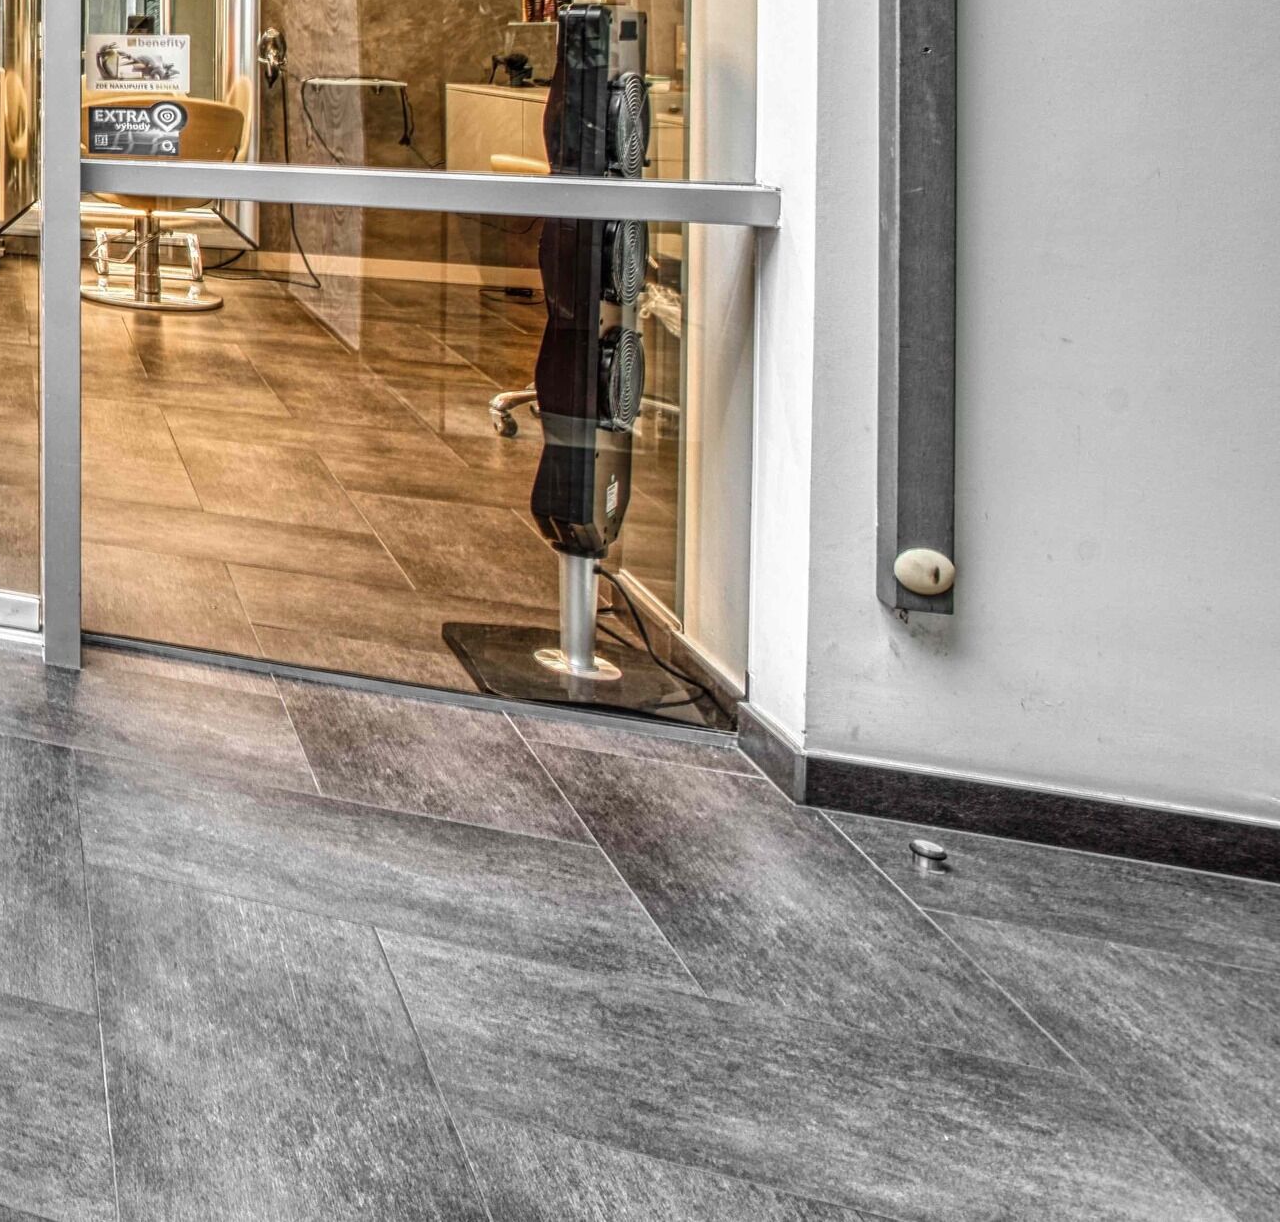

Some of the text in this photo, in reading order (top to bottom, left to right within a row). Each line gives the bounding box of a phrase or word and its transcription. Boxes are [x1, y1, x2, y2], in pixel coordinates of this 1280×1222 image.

[137, 38, 187, 50] benefity
[95, 82, 108, 90] ZDE
[94, 109, 151, 123] EXTRA
[115, 122, 151, 133] výhody
